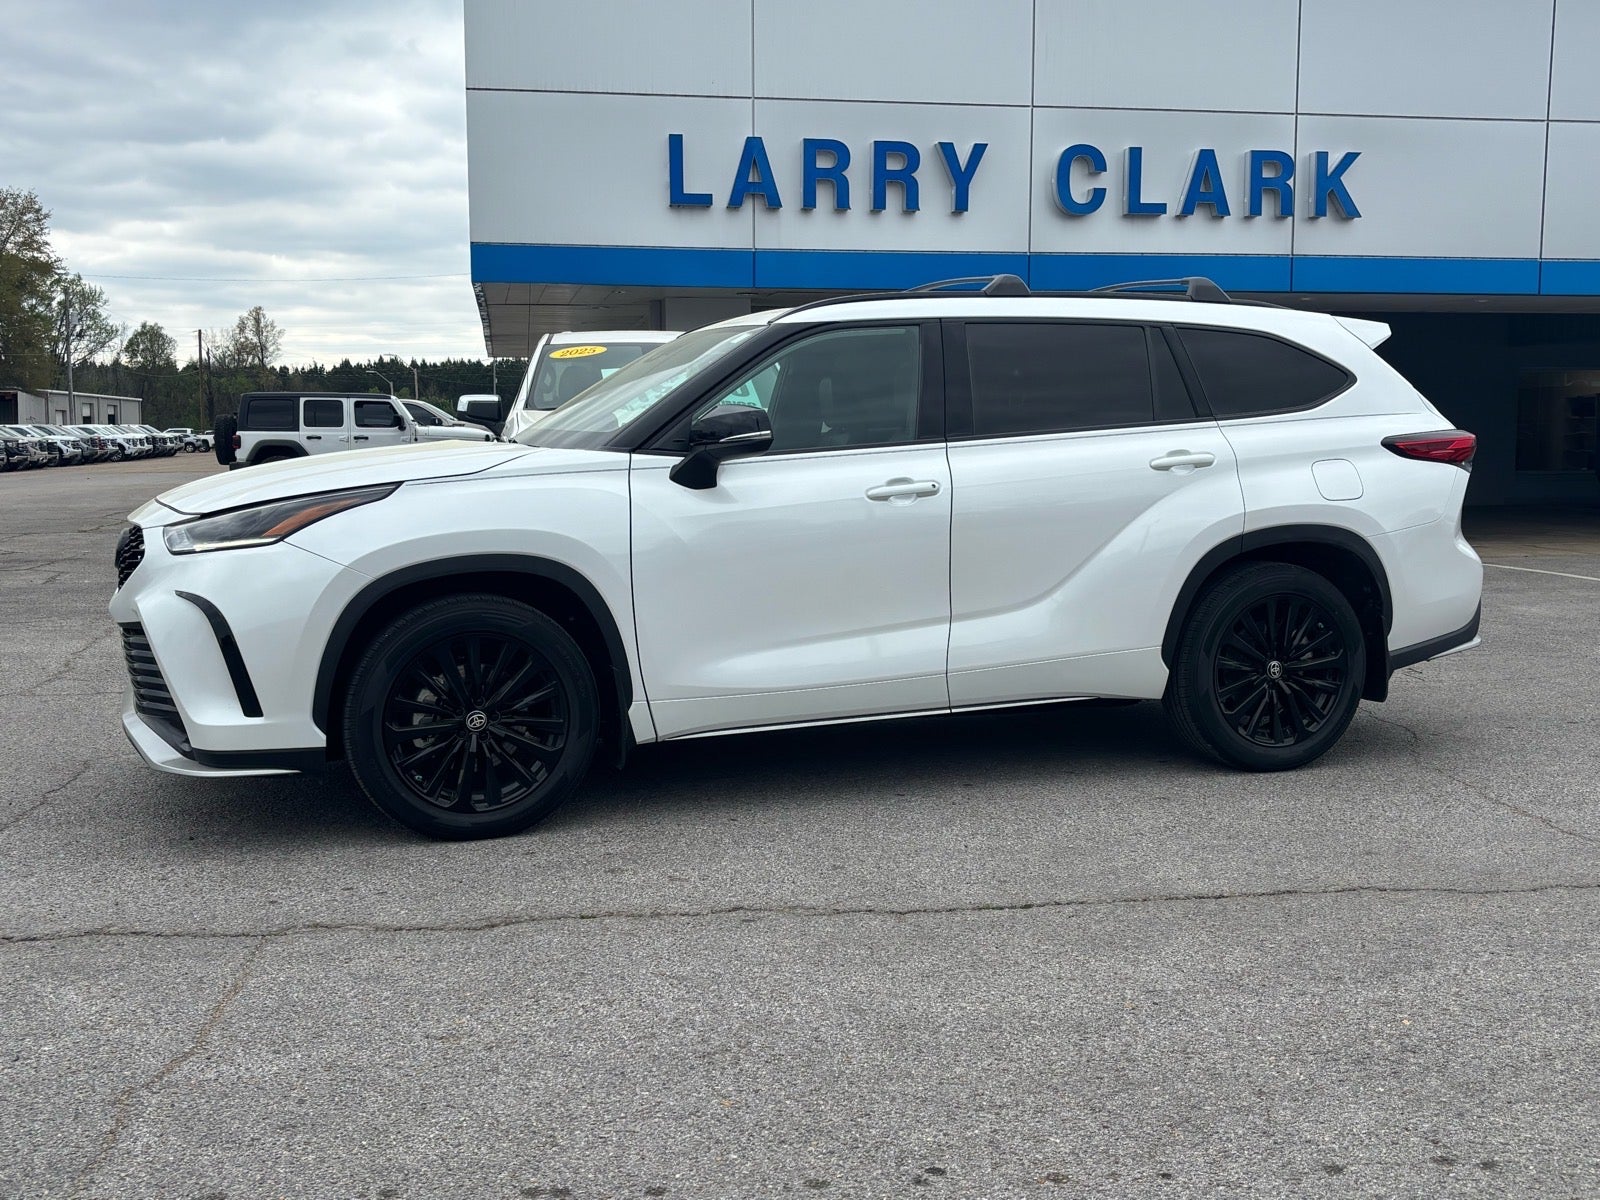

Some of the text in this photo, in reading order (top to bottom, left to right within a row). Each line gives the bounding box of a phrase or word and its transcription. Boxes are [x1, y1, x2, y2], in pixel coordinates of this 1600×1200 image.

[668, 133, 1362, 219] LARRY CLARK
[560, 347, 597, 357] 2025
